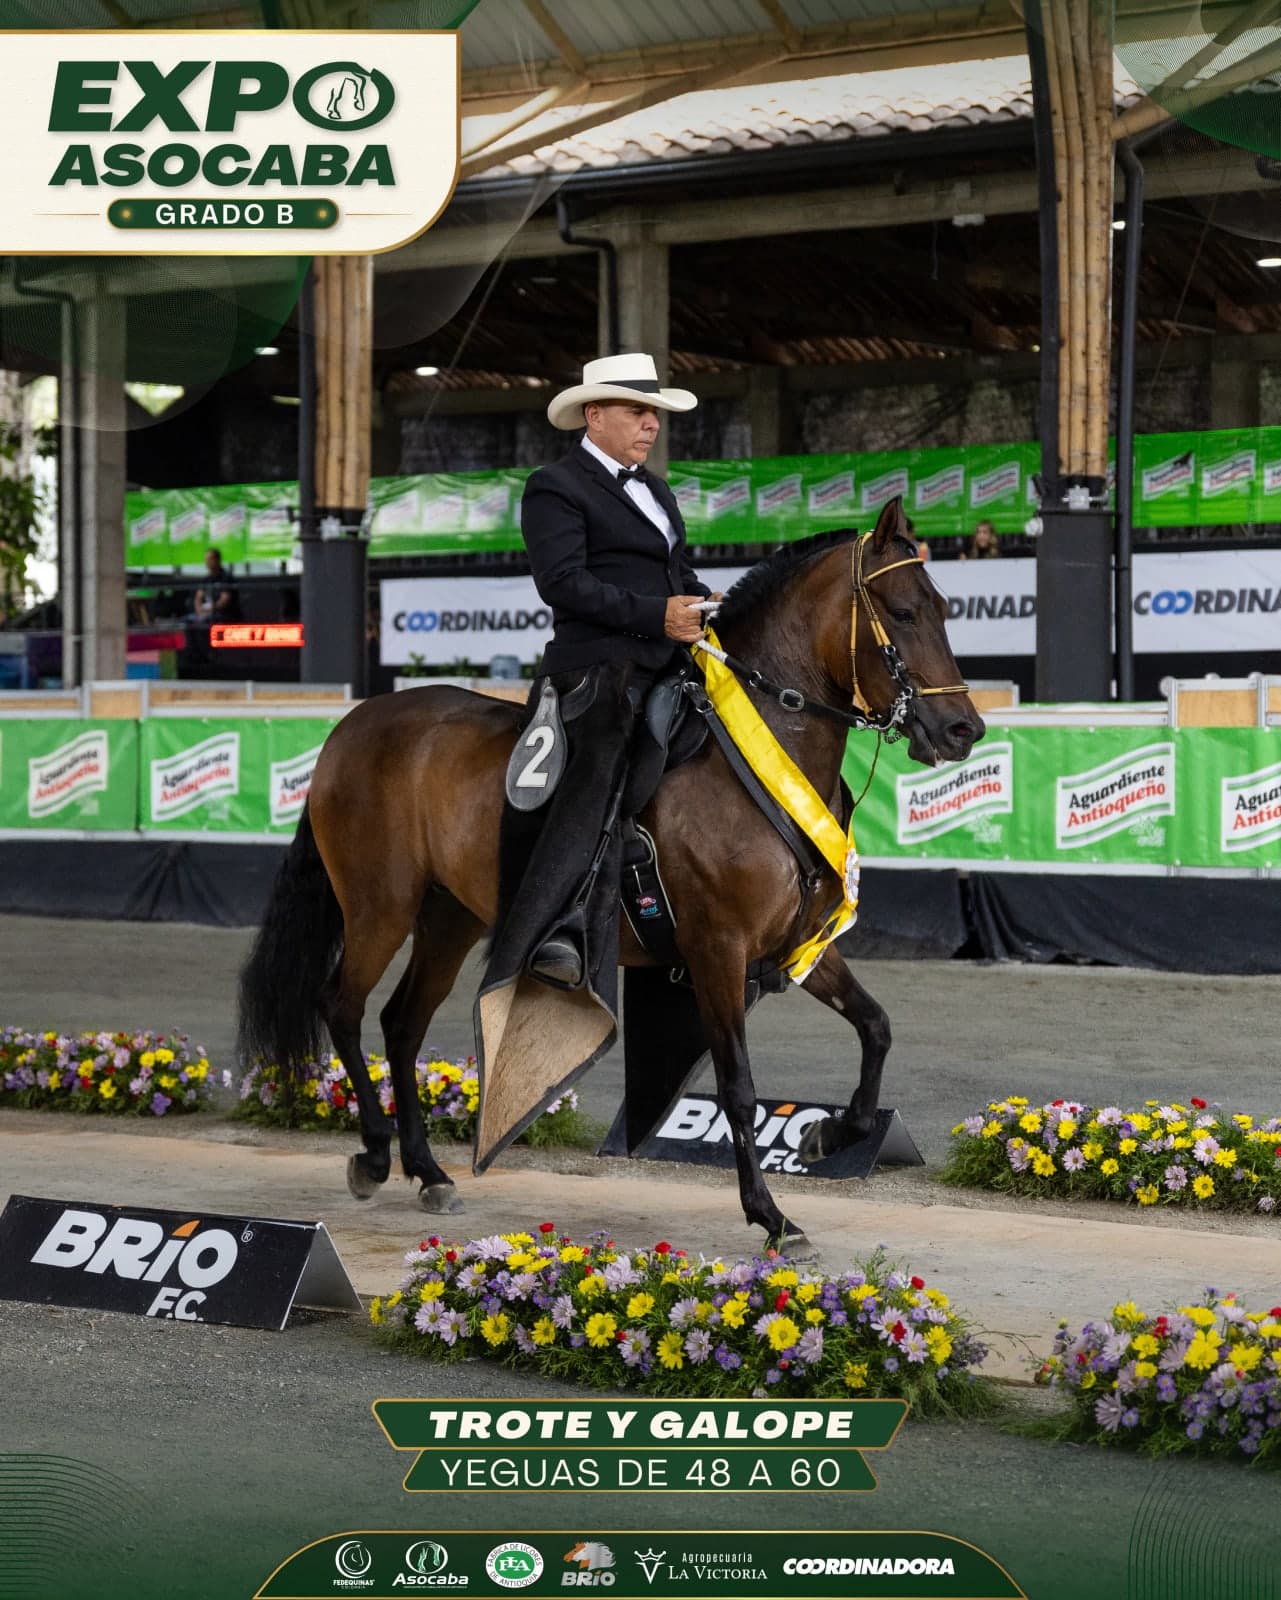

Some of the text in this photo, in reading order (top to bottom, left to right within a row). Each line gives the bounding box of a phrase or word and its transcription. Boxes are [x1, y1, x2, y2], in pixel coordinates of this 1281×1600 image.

[516, 726, 555, 788] 2
[908, 779, 1002, 824] Antioqueño
[909, 764, 1000, 806] Aguardiente
[1067, 780, 1166, 828] Antioqueño
[1069, 765, 1165, 809] Aguardiente
[1235, 785, 1281, 812] Agua
